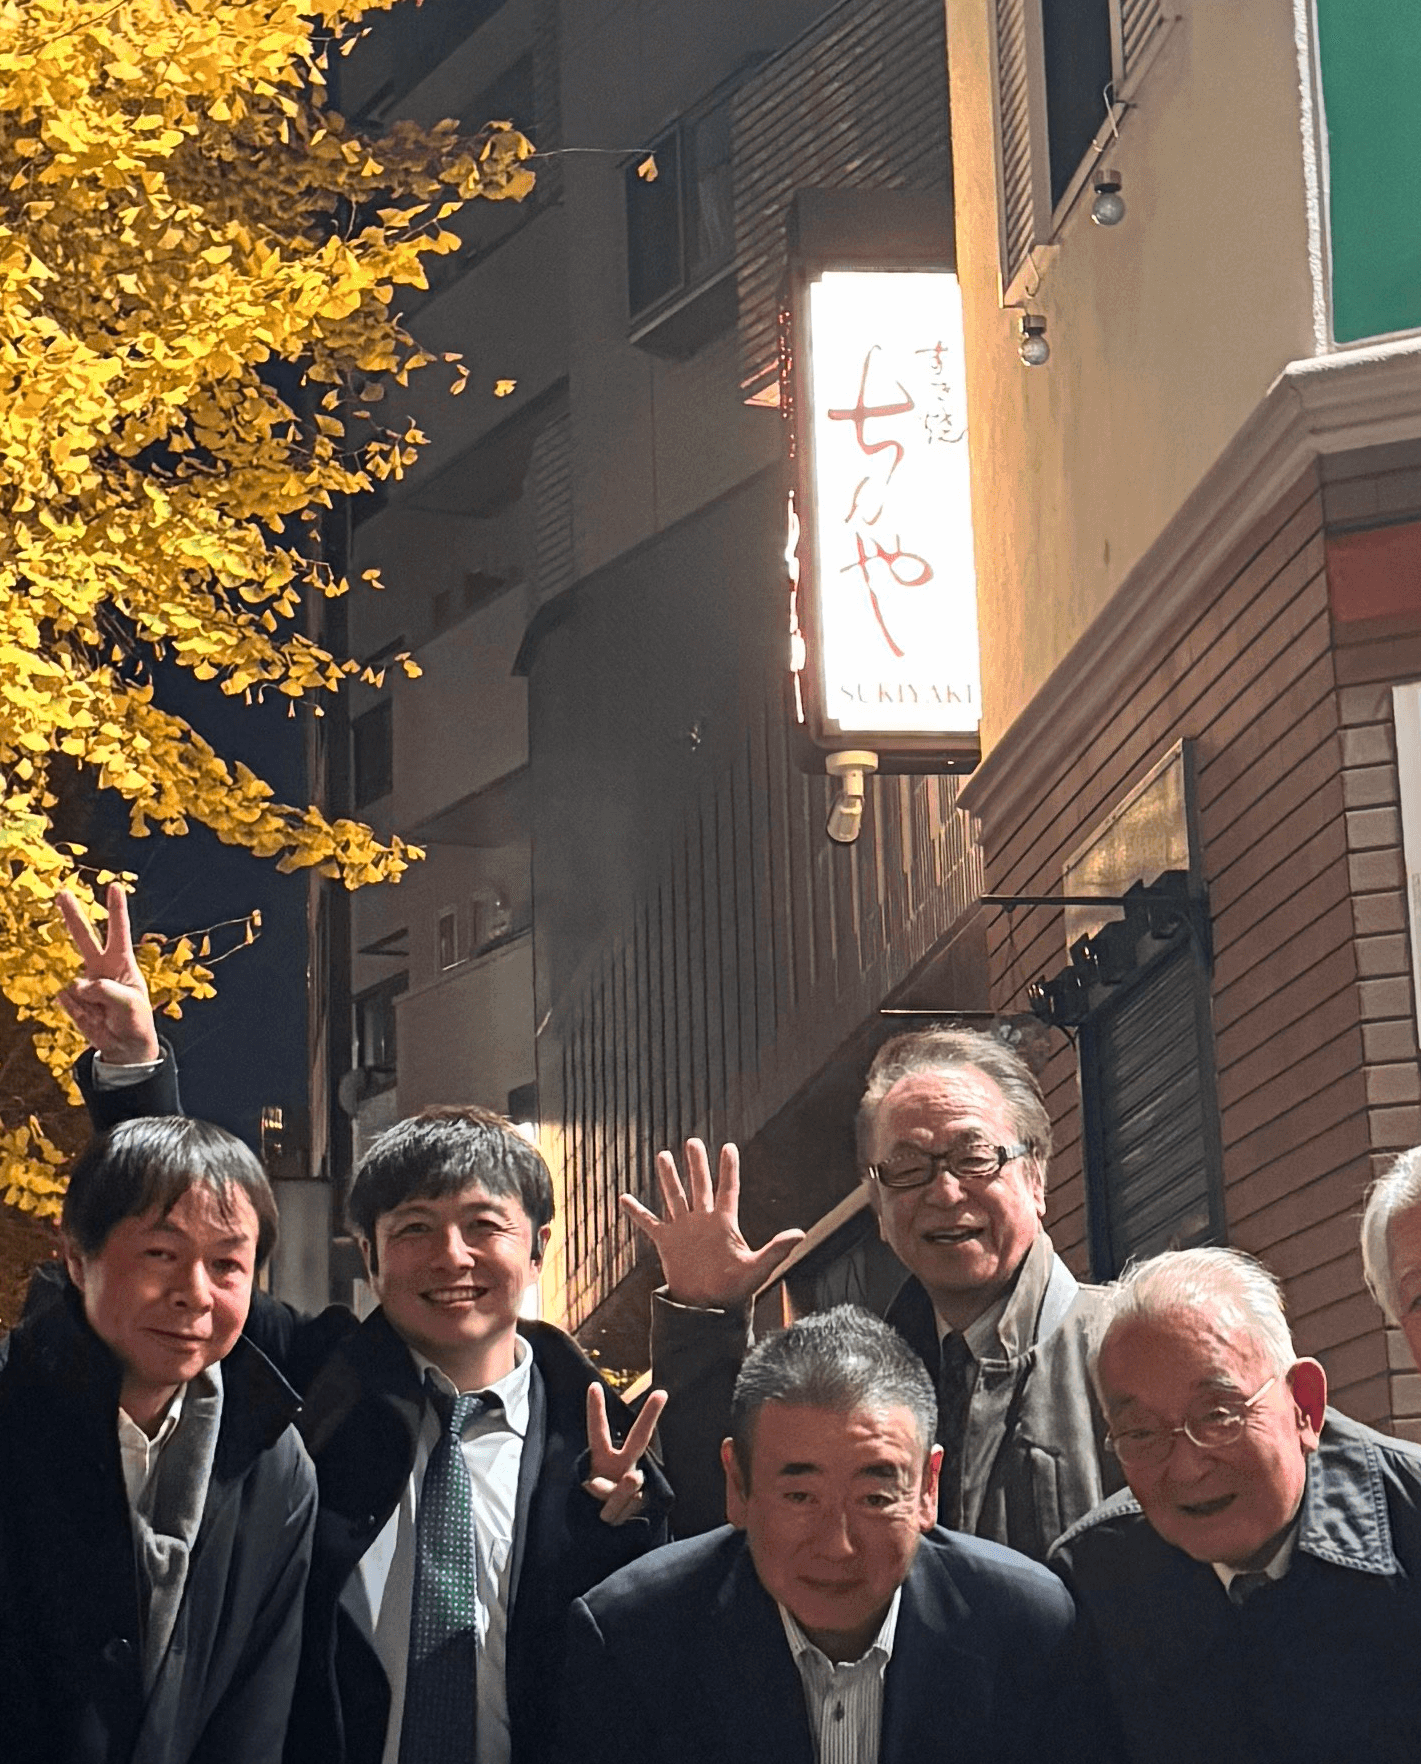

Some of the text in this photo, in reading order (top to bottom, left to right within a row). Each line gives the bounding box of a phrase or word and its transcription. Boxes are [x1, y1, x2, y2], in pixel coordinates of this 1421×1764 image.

[827, 344, 935, 658] ちんや
[840, 684, 975, 705] SUKIYAKI
